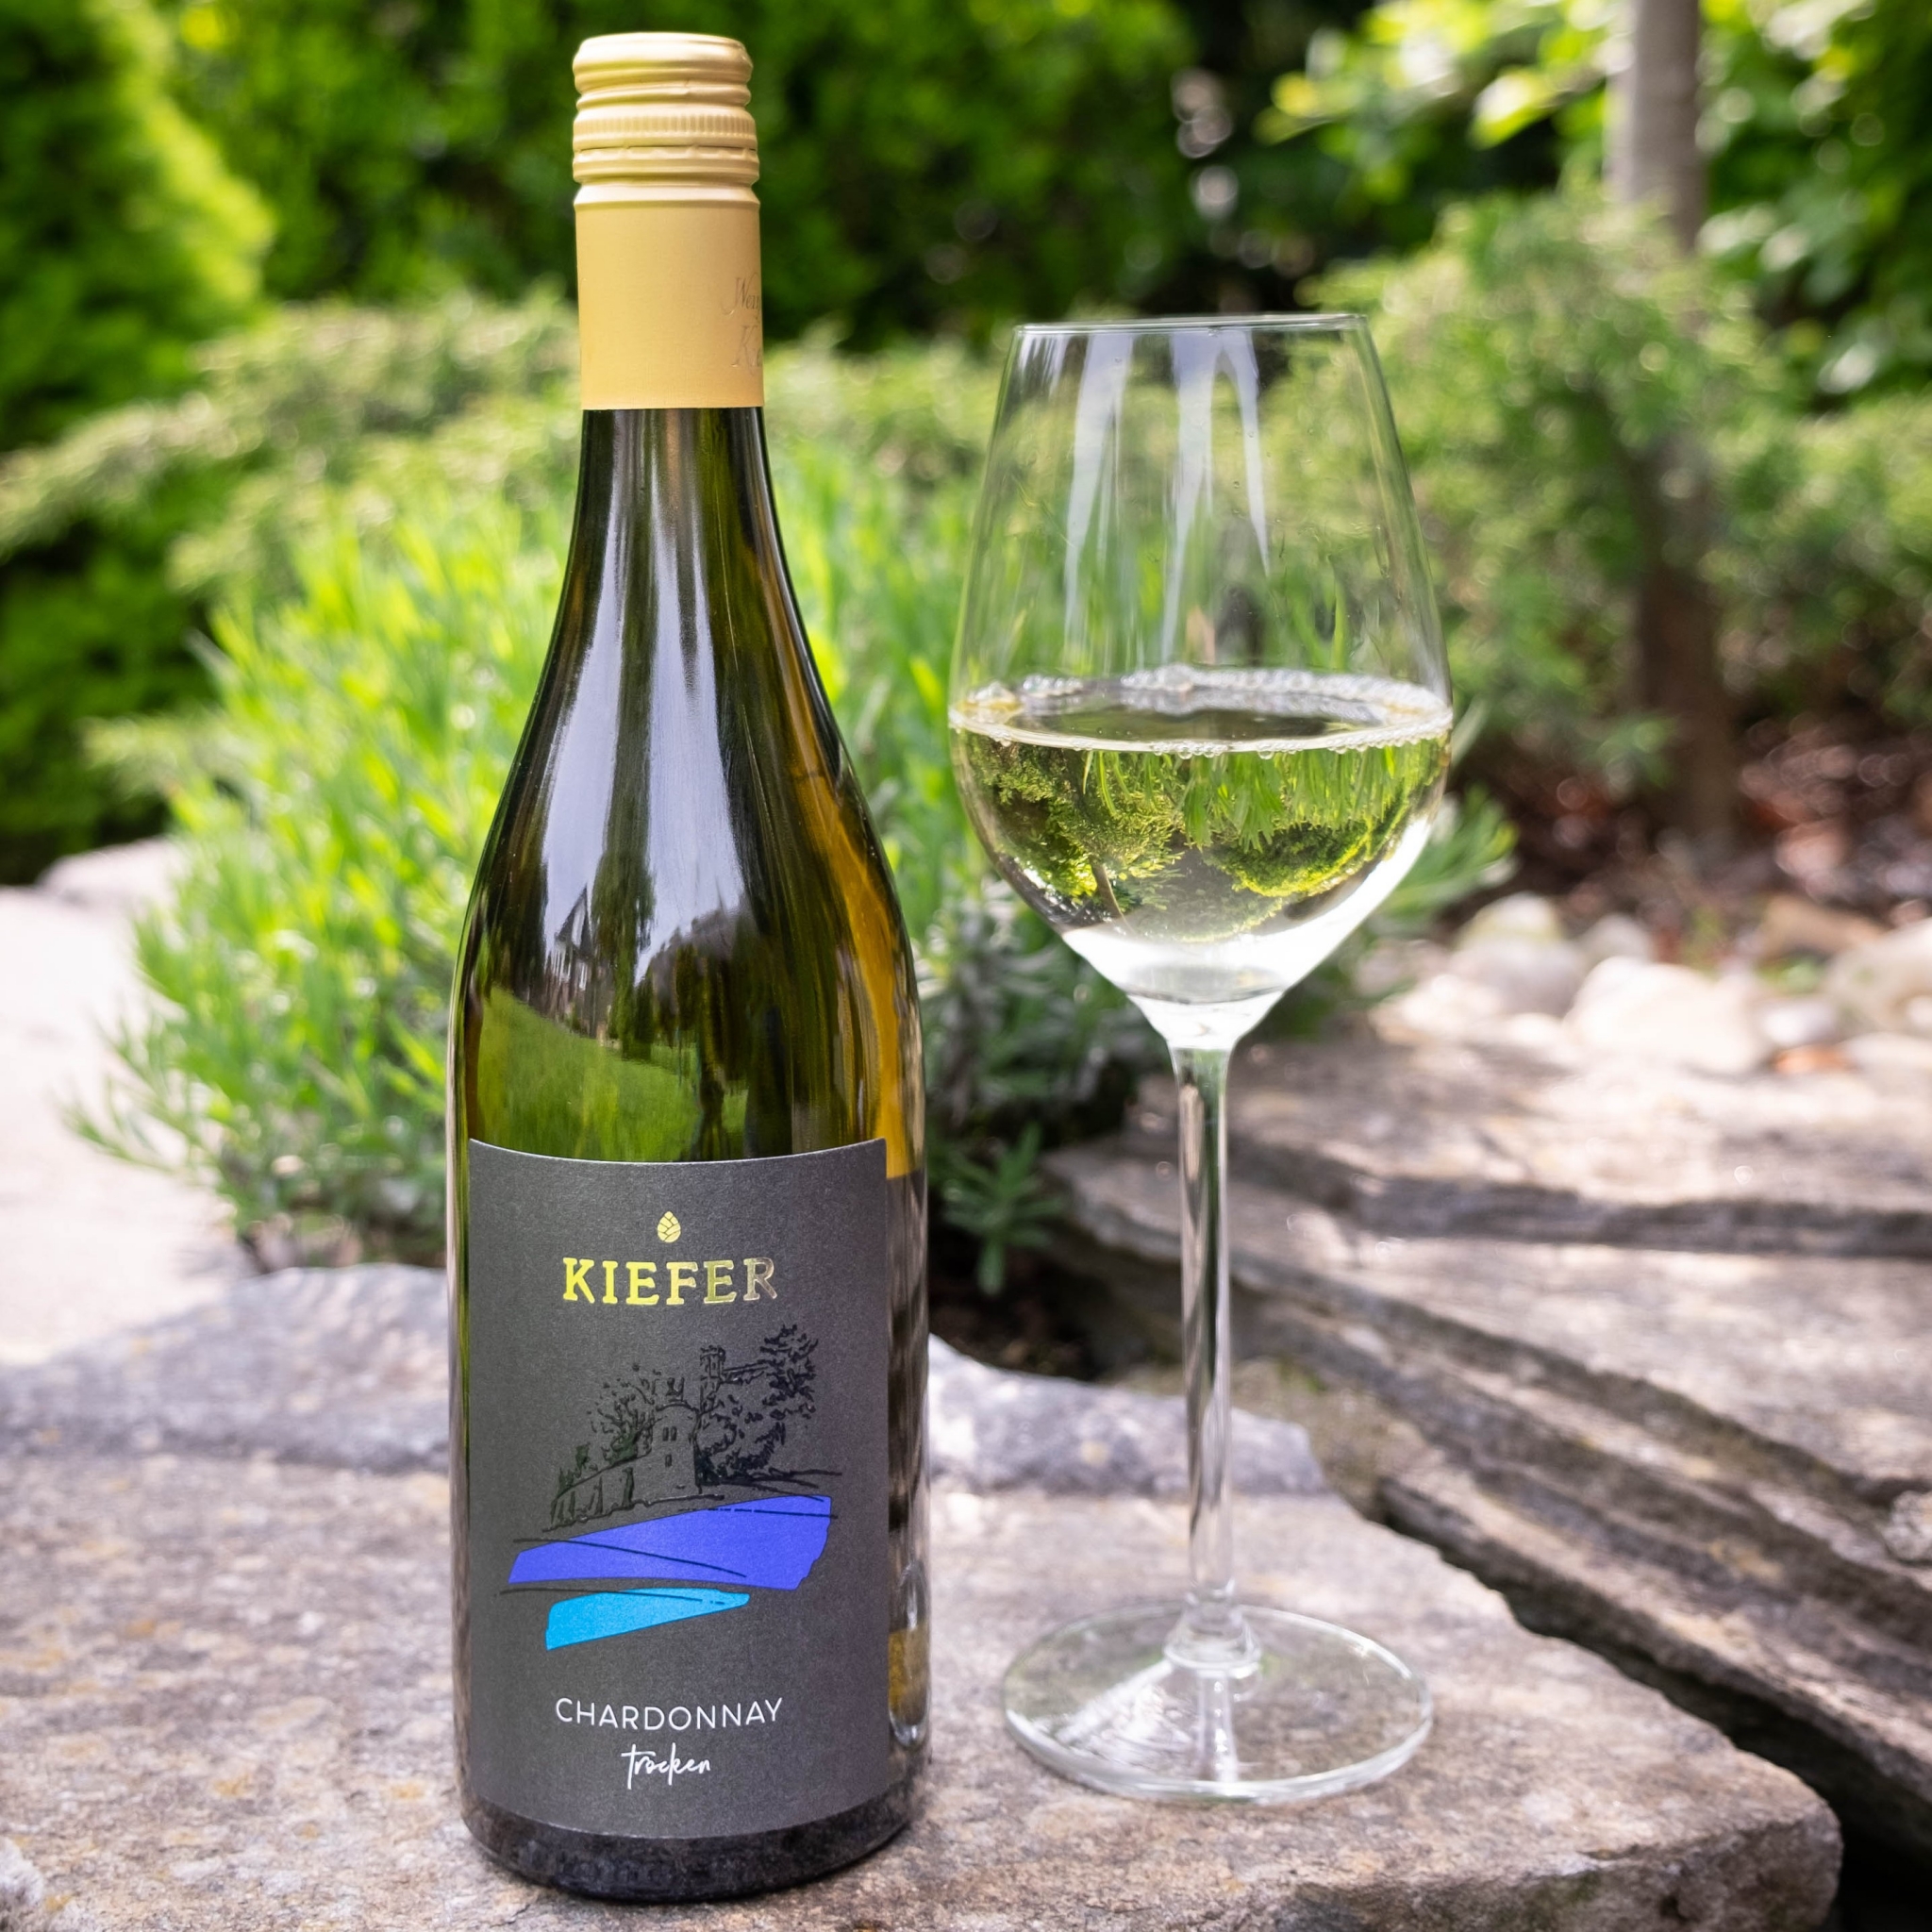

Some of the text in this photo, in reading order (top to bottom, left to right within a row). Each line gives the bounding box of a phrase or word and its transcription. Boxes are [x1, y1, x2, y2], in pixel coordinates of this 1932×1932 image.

[563, 1257, 777, 1305] KIEFER
[556, 1697, 782, 1730] CHARDONNAY
[621, 1742, 710, 1790] trocken
